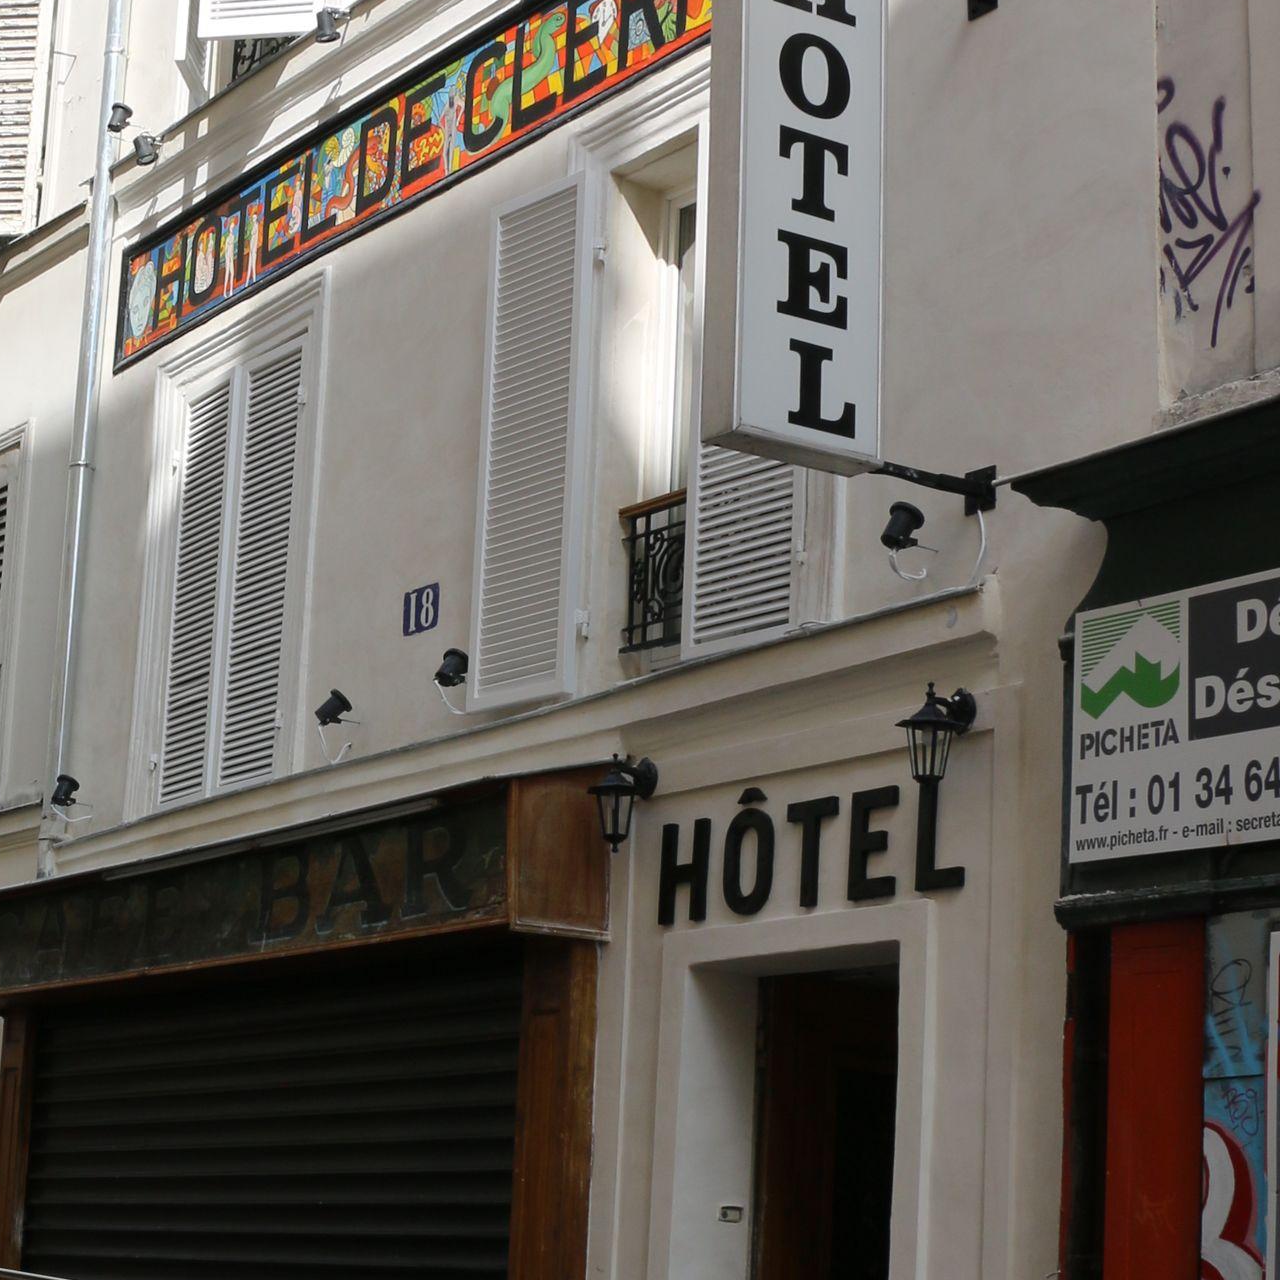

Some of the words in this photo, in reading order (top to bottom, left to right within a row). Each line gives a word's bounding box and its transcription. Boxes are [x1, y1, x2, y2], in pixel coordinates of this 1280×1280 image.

[152, 147, 338, 331] HOTEL
[356, 70, 447, 218] DE
[407, 588, 435, 633] 18
[1195, 667, 1280, 720] Dés
[1080, 718, 1180, 760] PICHETA
[1076, 780, 1118, 825] Tél
[1147, 772, 1180, 816] 01
[1195, 764, 1233, 809] 34
[1244, 756, 1280, 803] 64
[657, 782, 965, 926] HÔTEL
[1076, 826, 1168, 851] www.picheta.fr
[1182, 818, 1224, 839] e-mail
[249, 824, 468, 947] BAR
